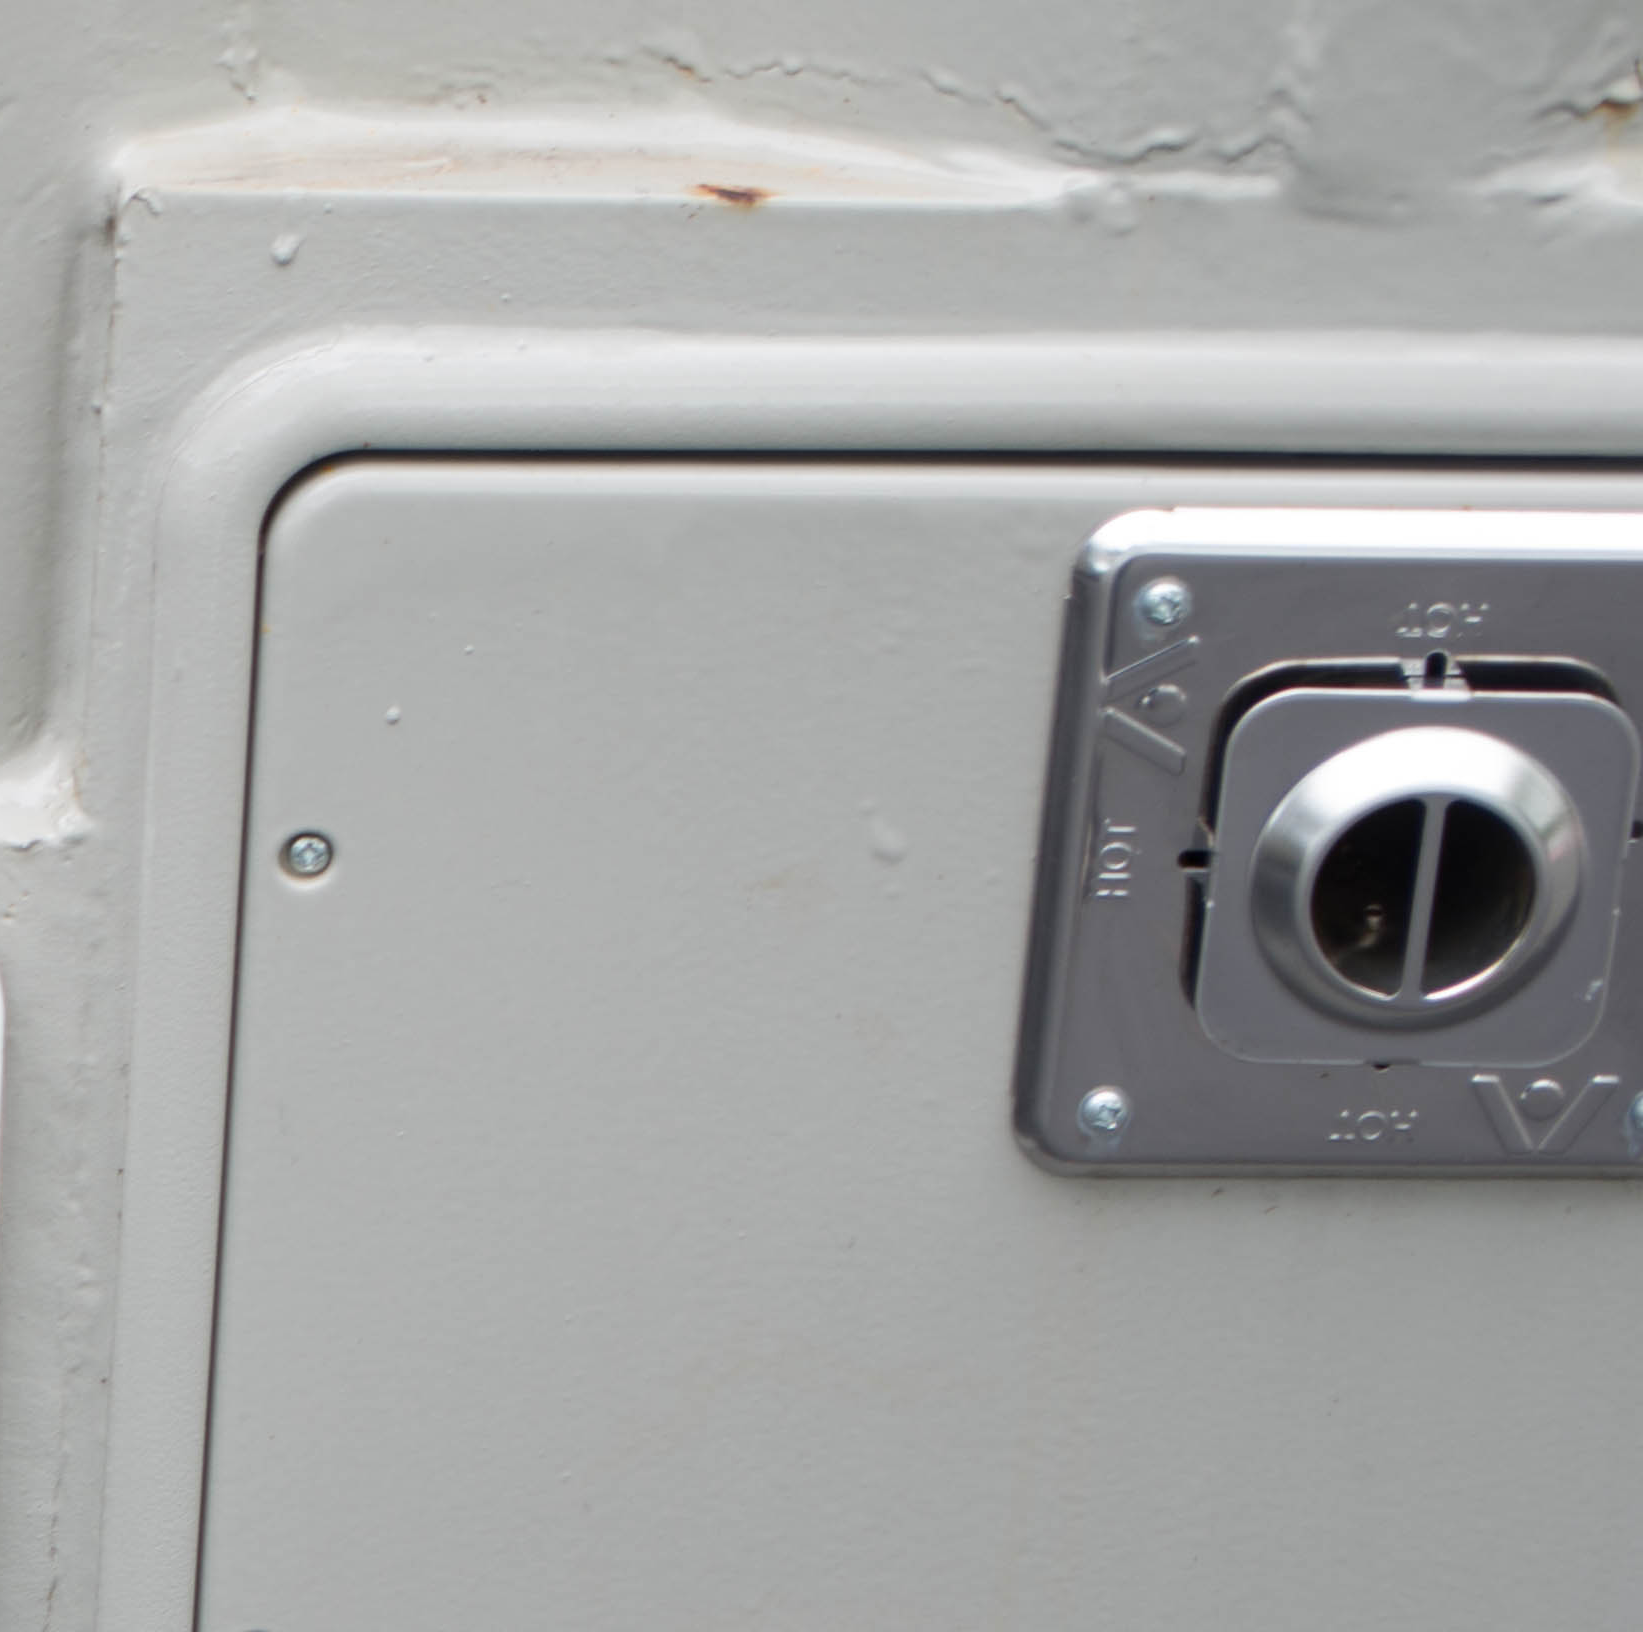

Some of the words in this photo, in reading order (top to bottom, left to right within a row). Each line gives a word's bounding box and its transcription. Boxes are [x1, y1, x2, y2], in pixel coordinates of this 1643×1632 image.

[1395, 602, 1490, 638] HOT
[1095, 818, 1139, 898] HOT
[1327, 1109, 1417, 1141] HOT
